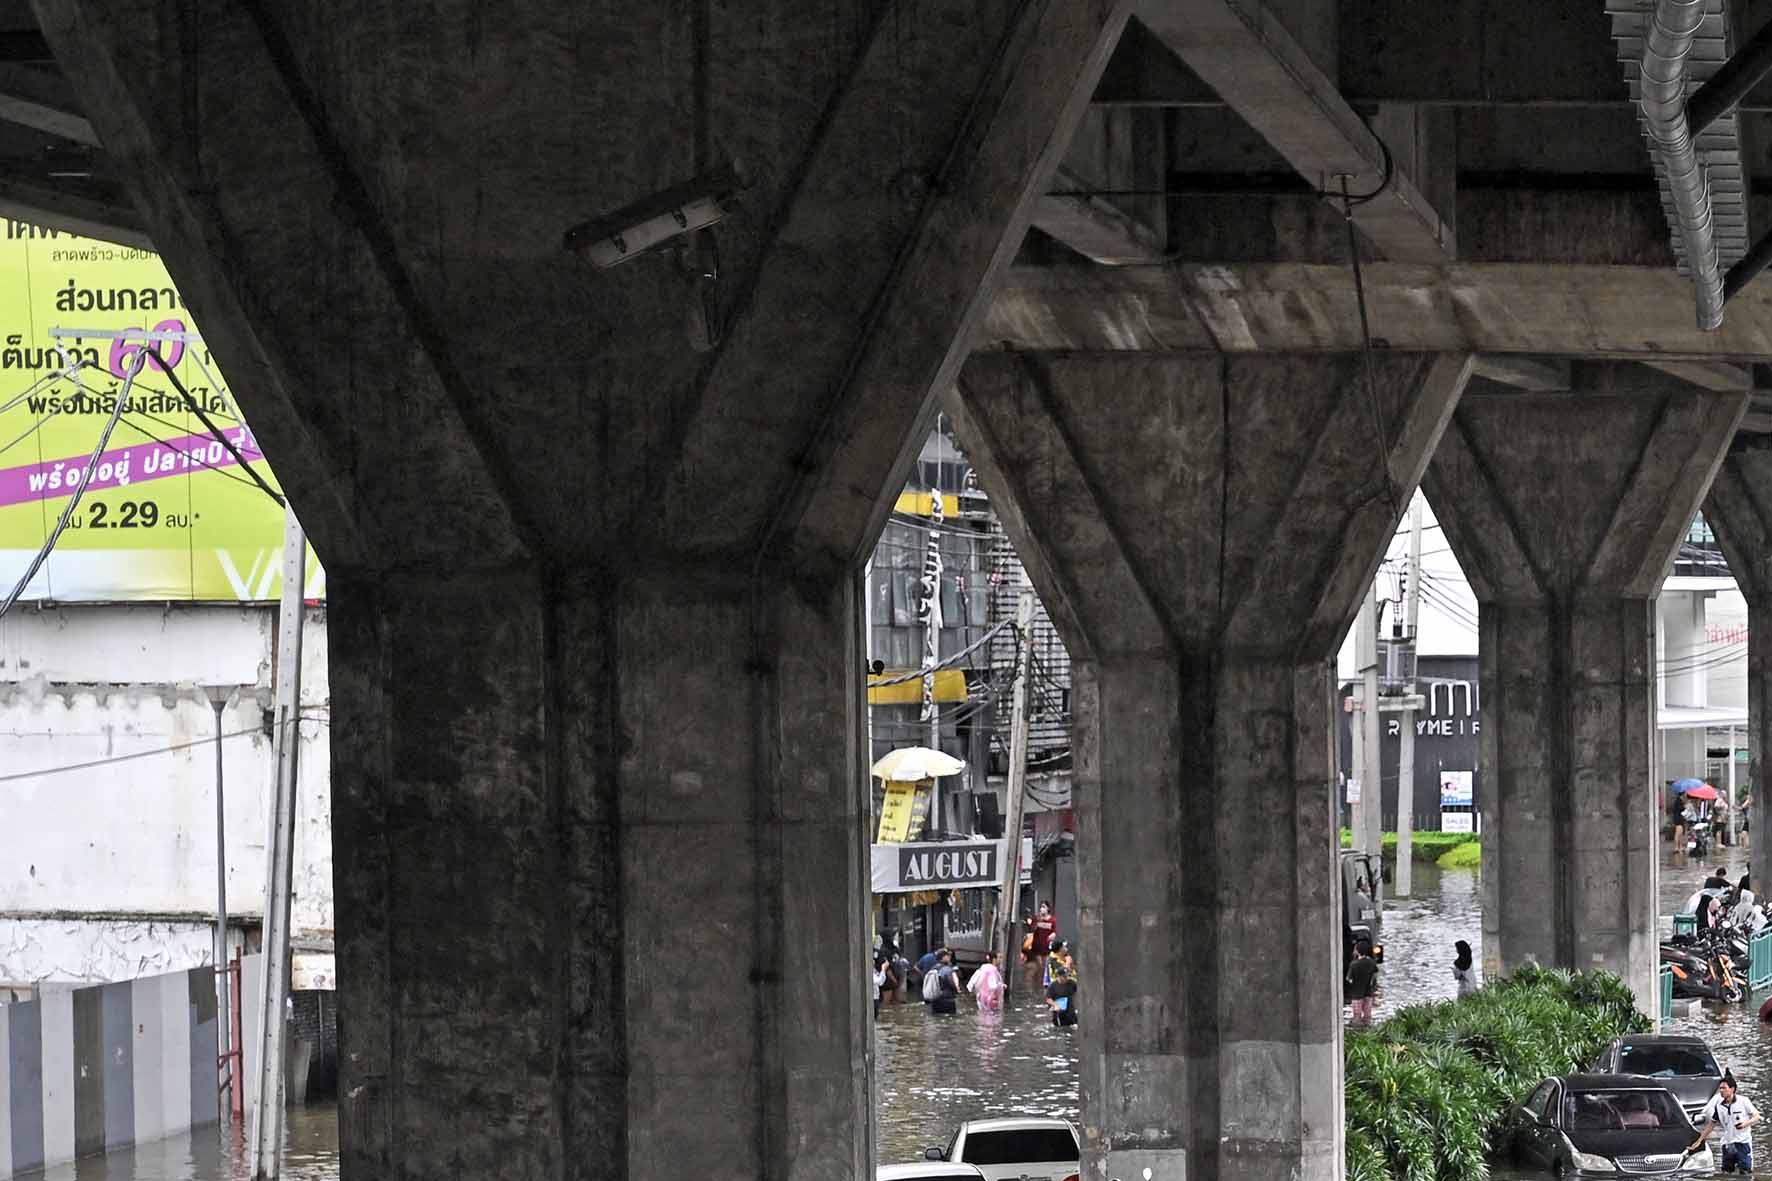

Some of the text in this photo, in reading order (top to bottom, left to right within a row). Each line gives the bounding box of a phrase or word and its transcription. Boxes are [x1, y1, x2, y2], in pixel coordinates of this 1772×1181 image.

[56, 278, 187, 312] ส่วนกลา
[109, 319, 187, 381] 60
[89, 501, 159, 528] 2.29
[1388, 719, 1454, 736] RYME
[904, 850, 992, 881] AUGUST
